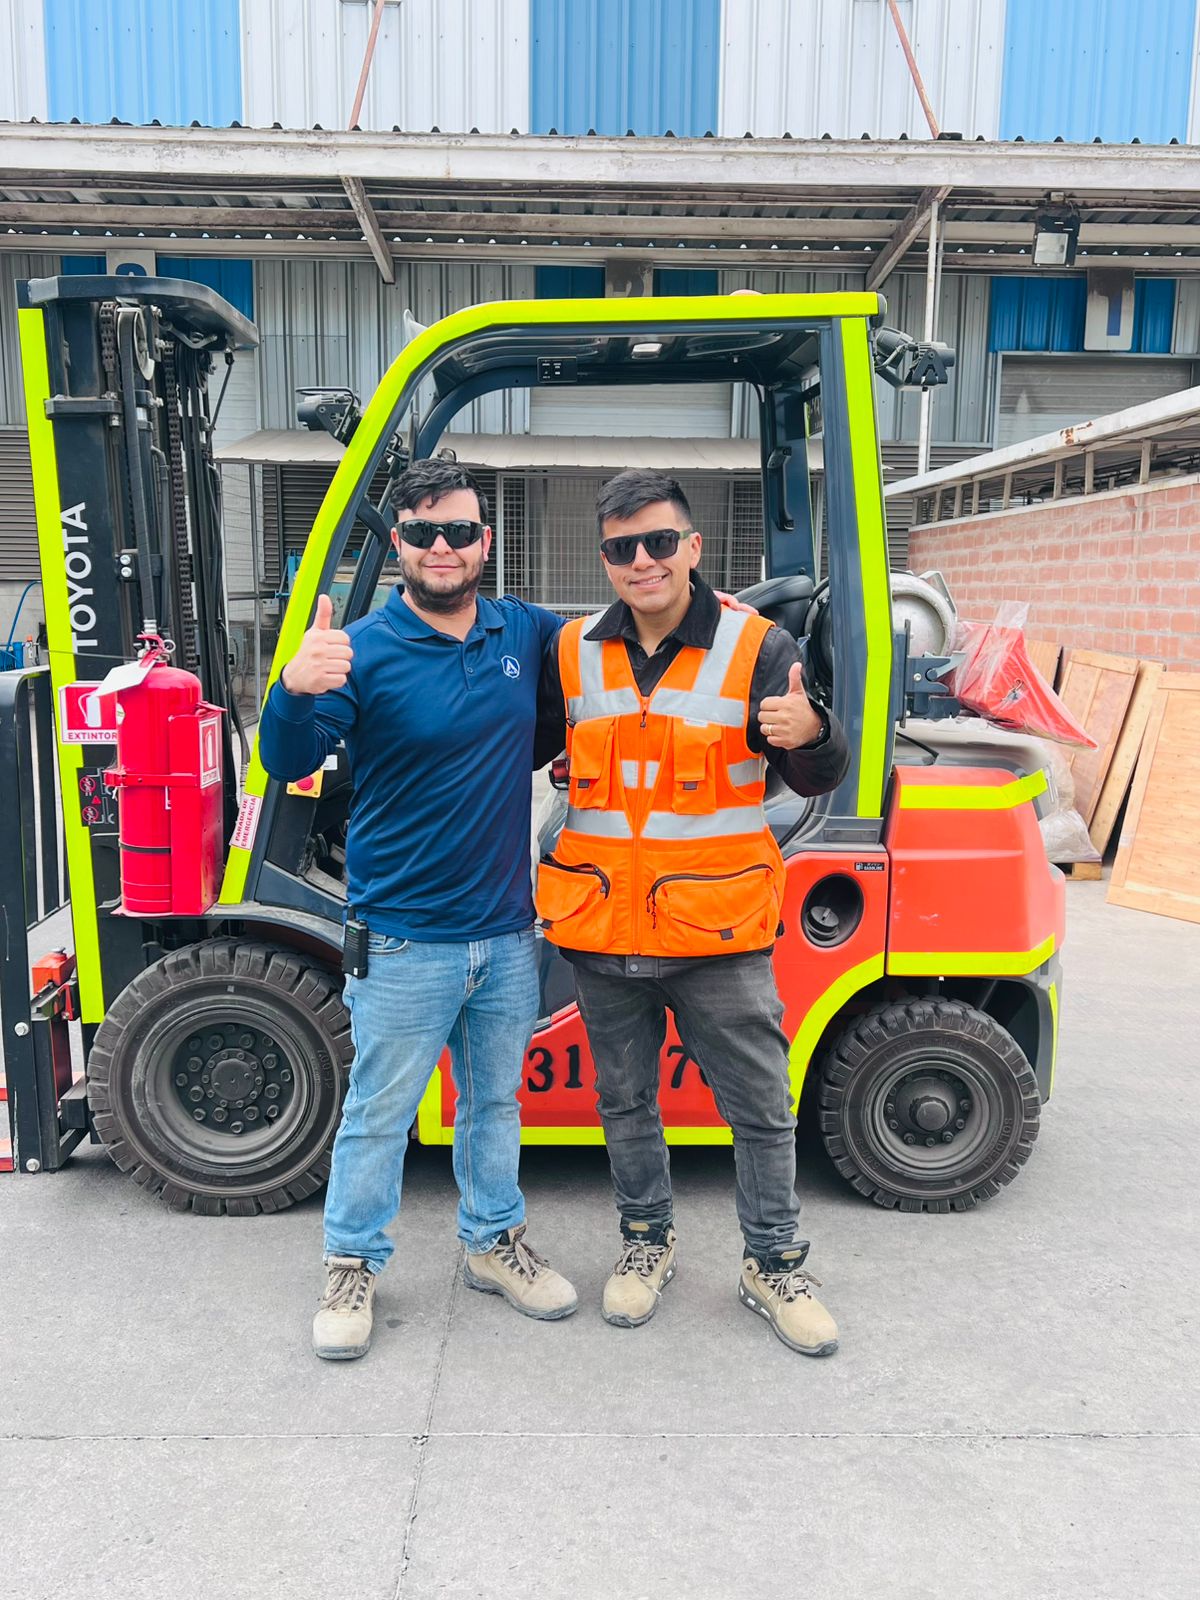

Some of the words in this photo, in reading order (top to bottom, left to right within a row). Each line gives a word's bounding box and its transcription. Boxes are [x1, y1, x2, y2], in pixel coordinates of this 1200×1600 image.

[60, 502, 98, 654] TOYOTA
[67, 731, 118, 740] EXTINTOR
[235, 811, 245, 842] PARADA
[241, 797, 257, 847] EMERGENCIA
